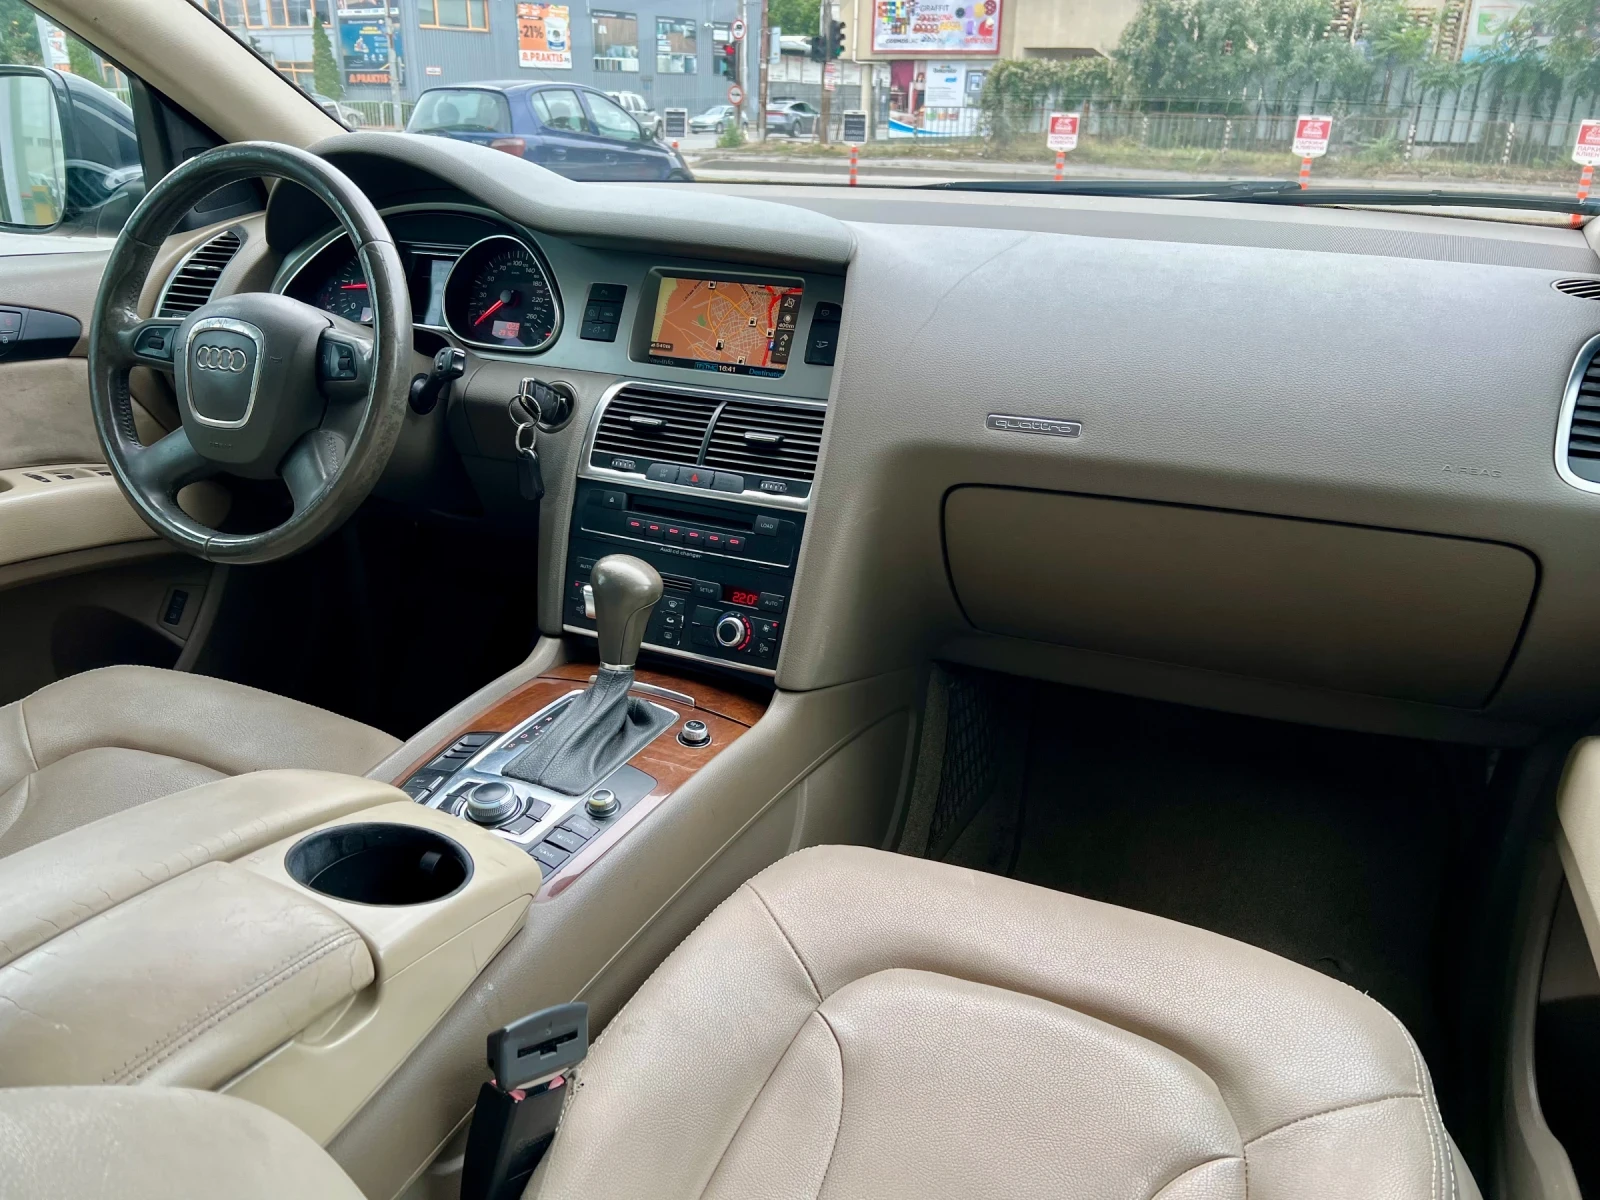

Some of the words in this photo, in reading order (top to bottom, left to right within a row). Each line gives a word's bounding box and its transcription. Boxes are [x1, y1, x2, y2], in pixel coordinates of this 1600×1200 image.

[519, 25, 544, 38] -21%
[995, 420, 1072, 433] quattro
[659, 546, 673, 554] Audi
[699, 586, 714, 594] SETUP
[556, 833, 574, 845] MEDIA
